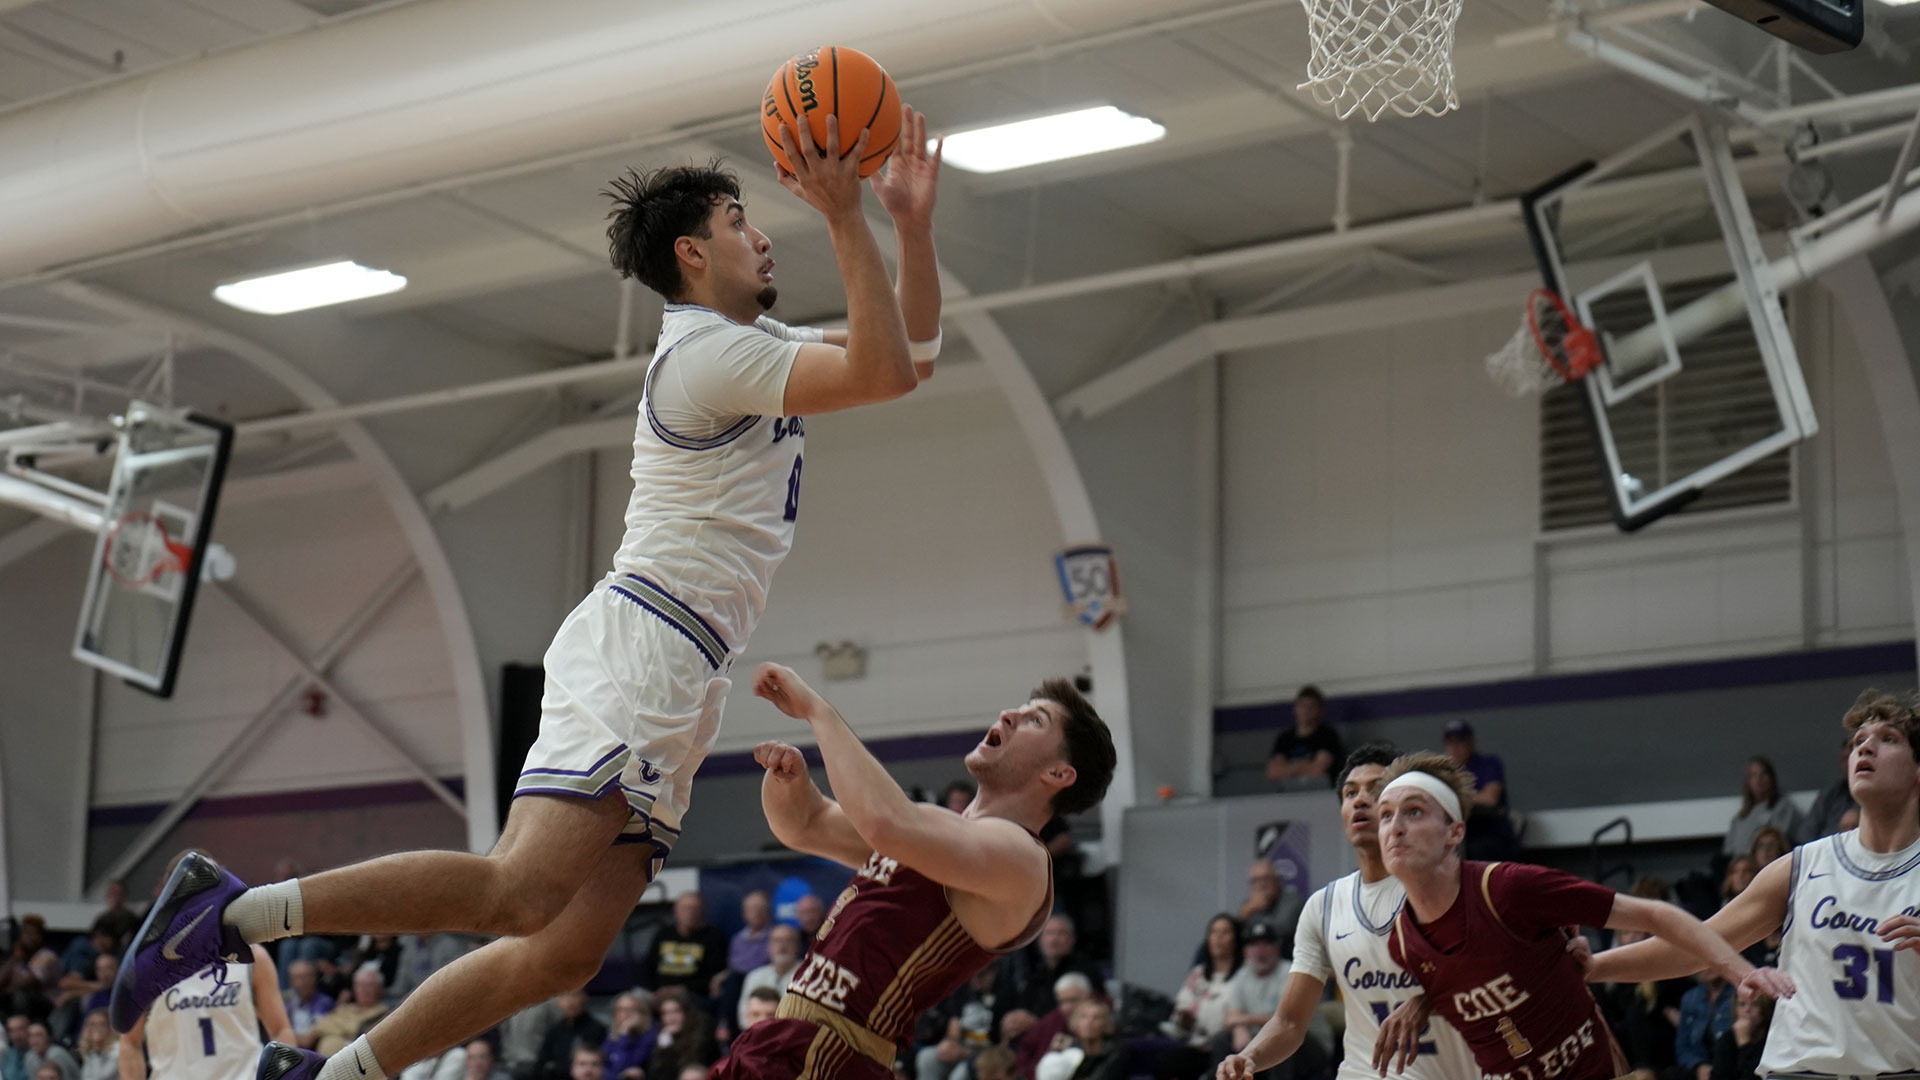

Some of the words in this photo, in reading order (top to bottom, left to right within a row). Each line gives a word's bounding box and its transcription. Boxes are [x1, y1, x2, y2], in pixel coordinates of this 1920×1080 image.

[796, 47, 819, 113] lson
[1071, 565, 1108, 597] 50
[1810, 895, 1920, 935] Corn
[1343, 956, 1422, 990] Corne
[1832, 943, 1895, 1004] 31
[165, 981, 242, 1012] Cornell
[1453, 972, 1530, 1022] COE
[198, 1017, 216, 1057] 1
[1495, 1015, 1534, 1060] 1
